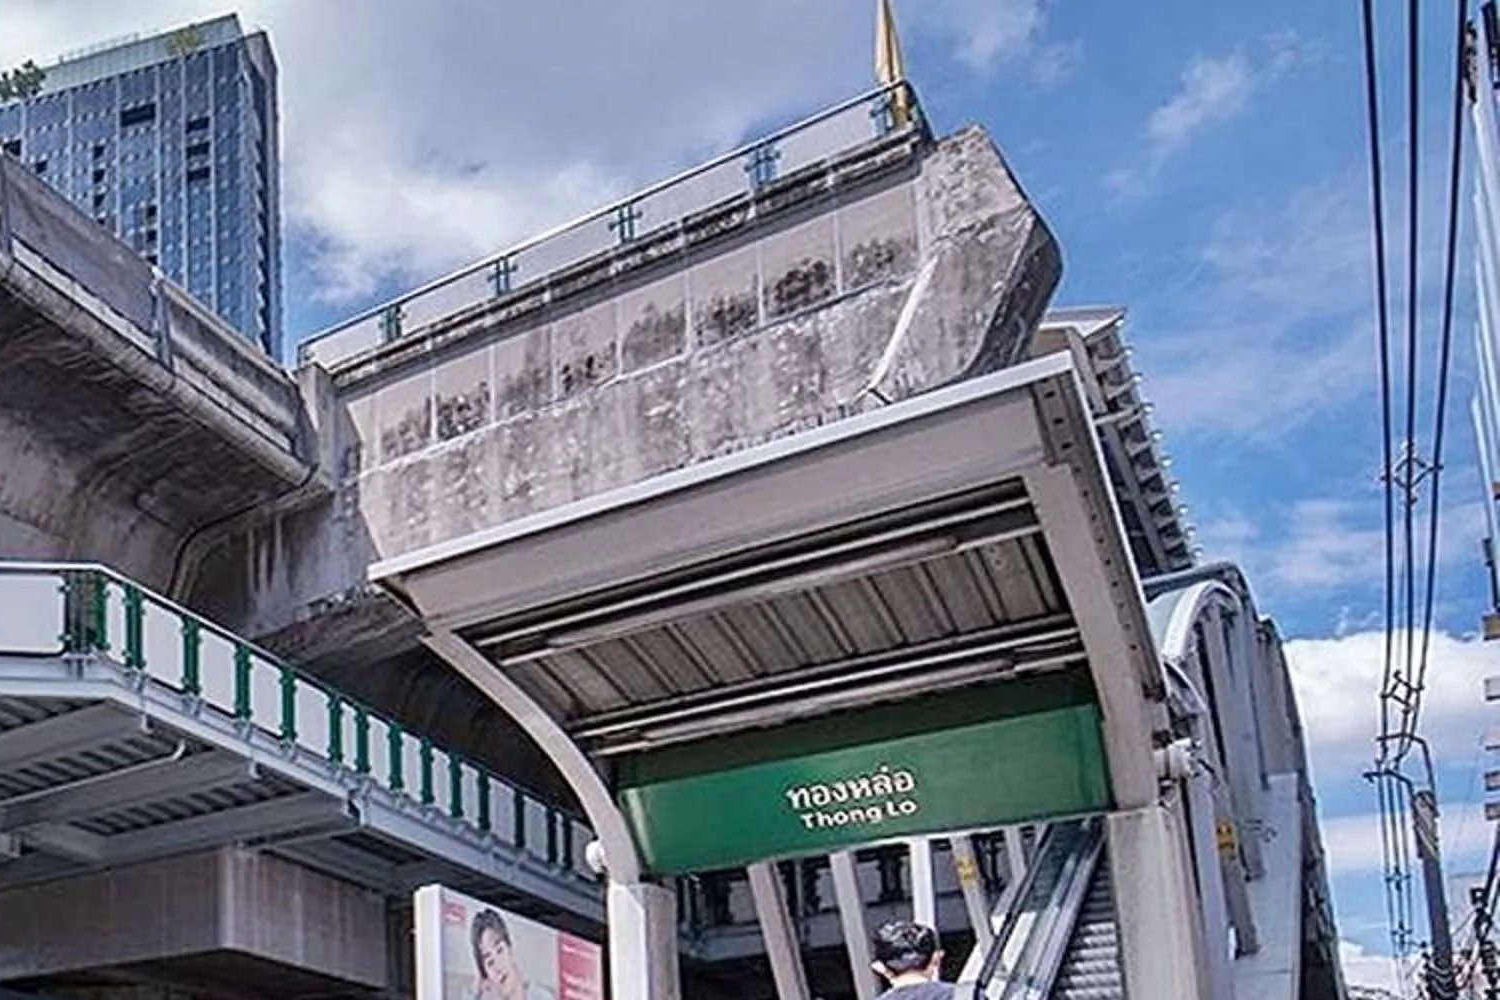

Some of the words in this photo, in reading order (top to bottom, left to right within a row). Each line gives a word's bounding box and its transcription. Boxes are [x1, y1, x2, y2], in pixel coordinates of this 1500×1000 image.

[786, 765, 915, 809] ทองหล่อ
[800, 806, 883, 828] Thong
[886, 799, 917, 817] Lo
